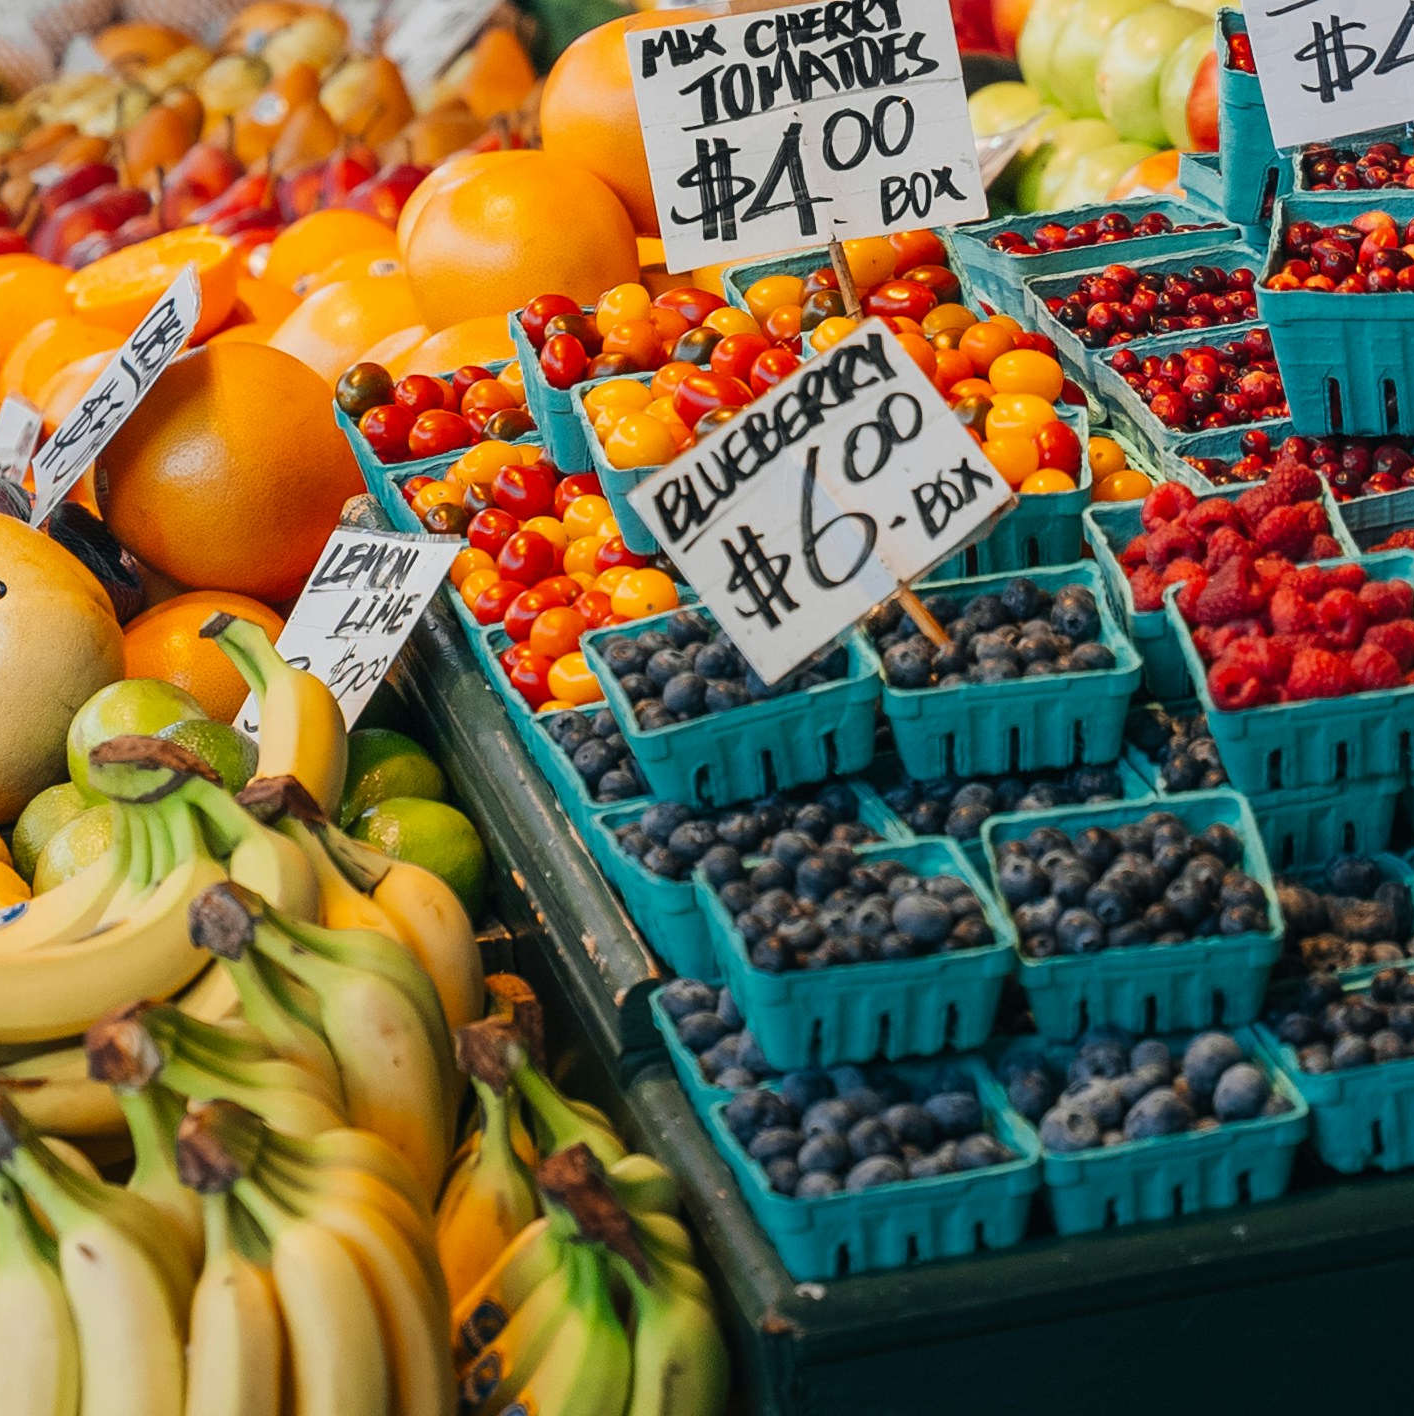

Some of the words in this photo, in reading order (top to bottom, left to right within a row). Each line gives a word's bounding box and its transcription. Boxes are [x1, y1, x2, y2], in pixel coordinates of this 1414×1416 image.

[642, 24, 726, 79] MIX
[679, 31, 939, 125] TOMATOES
[671, 95, 915, 242] $4.00
[880, 166, 967, 226] BOX
[653, 333, 897, 543] BLUEBERRY
[912, 457, 993, 540] BOX
[311, 543, 420, 590] LEMON
[334, 593, 421, 634] LIME
